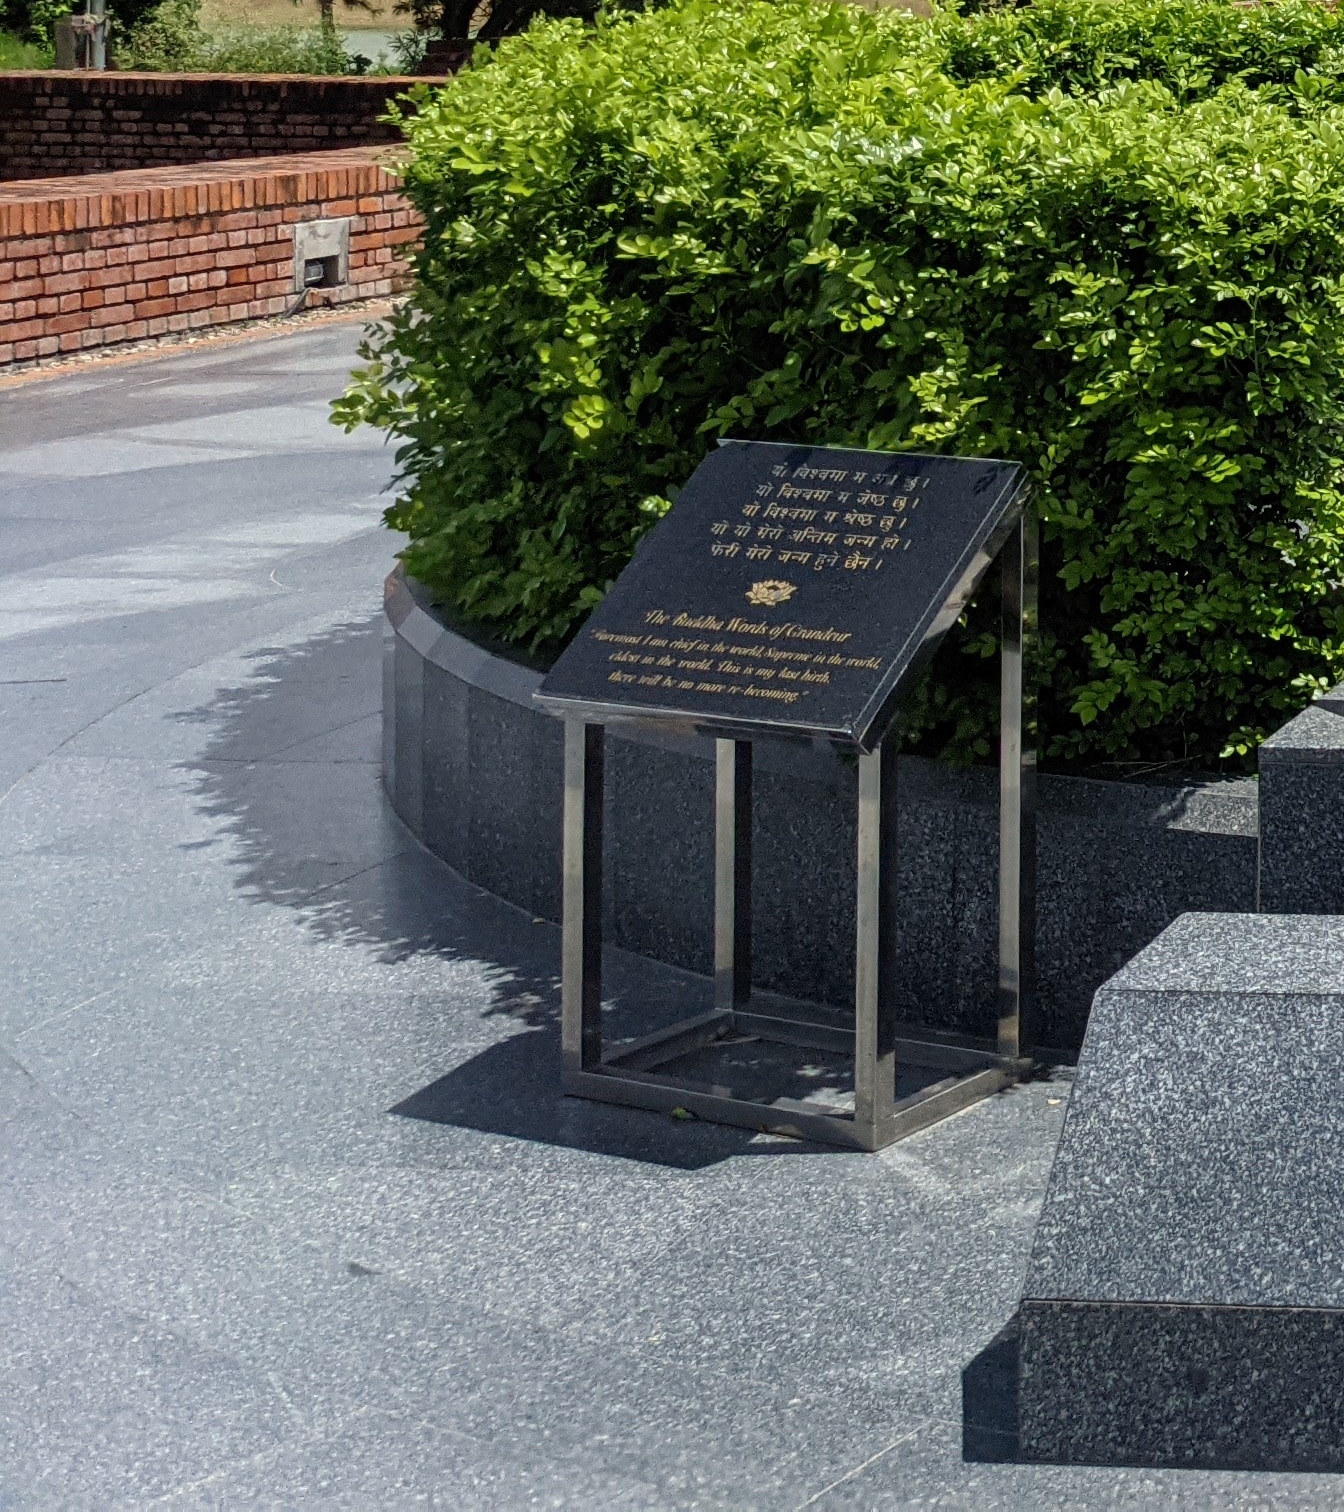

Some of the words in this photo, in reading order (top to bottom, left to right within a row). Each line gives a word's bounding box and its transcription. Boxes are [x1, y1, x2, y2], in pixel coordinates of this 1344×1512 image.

[777, 482, 834, 502] विश्वमा
[763, 502, 818, 522] विश्वमा
[644, 609, 671, 625] The
[672, 611, 725, 631] Buddha
[726, 617, 769, 636] Words
[769, 622, 791, 641] of
[785, 624, 852, 642] Grandeur
[697, 640, 710, 651] in
[711, 641, 729, 653] the
[812, 651, 828, 664] in
[827, 652, 847, 666] the
[640, 652, 656, 665] in
[655, 654, 677, 667] the
[717, 660, 742, 673] This
[742, 663, 755, 675] is
[754, 668, 777, 680] my
[777, 666, 801, 680] last
[637, 674, 663, 687] will
[661, 675, 678, 688] be
[678, 680, 695, 689] no
[696, 682, 727, 692] more
